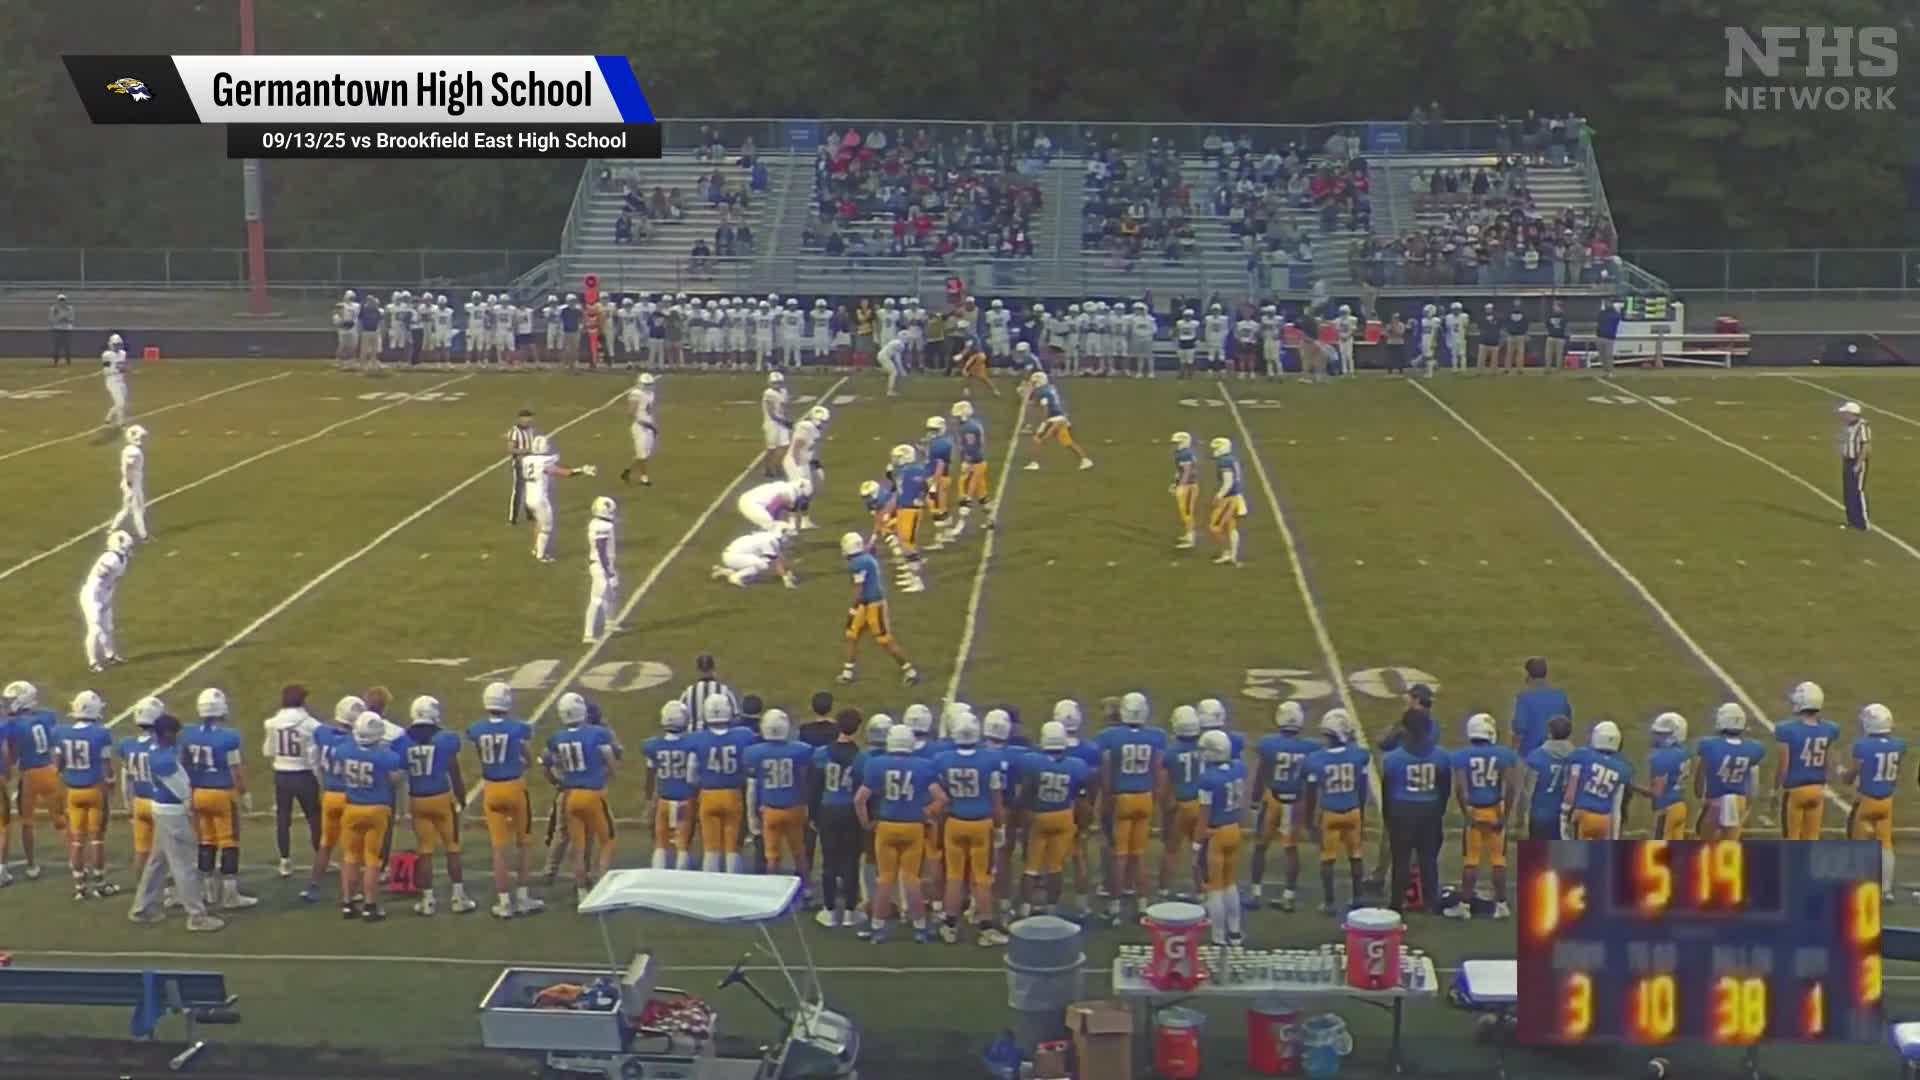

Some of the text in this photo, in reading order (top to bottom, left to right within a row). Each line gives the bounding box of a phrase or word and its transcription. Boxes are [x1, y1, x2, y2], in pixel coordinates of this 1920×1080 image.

[1240, 666, 1441, 699] 50
[64, 740, 90, 769] 13
[277, 729, 301, 757] 16
[1800, 737, 1828, 767] 45
[408, 745, 435, 775] 57
[707, 745, 738, 773] 46
[1121, 744, 1152, 774] 89
[1469, 757, 1498, 787] 24
[1719, 754, 1749, 783] 42
[1874, 752, 1900, 781] 16
[885, 771, 914, 801] 64
[948, 768, 980, 797] 53
[1584, 763, 1619, 797] 35
[1642, 841, 1673, 907] 5
[1698, 841, 1745, 904] 19
[1164, 936, 1186, 958] G
[1367, 940, 1386, 958] G
[1636, 975, 1676, 1039] 10
[1714, 976, 1768, 1039] 38
